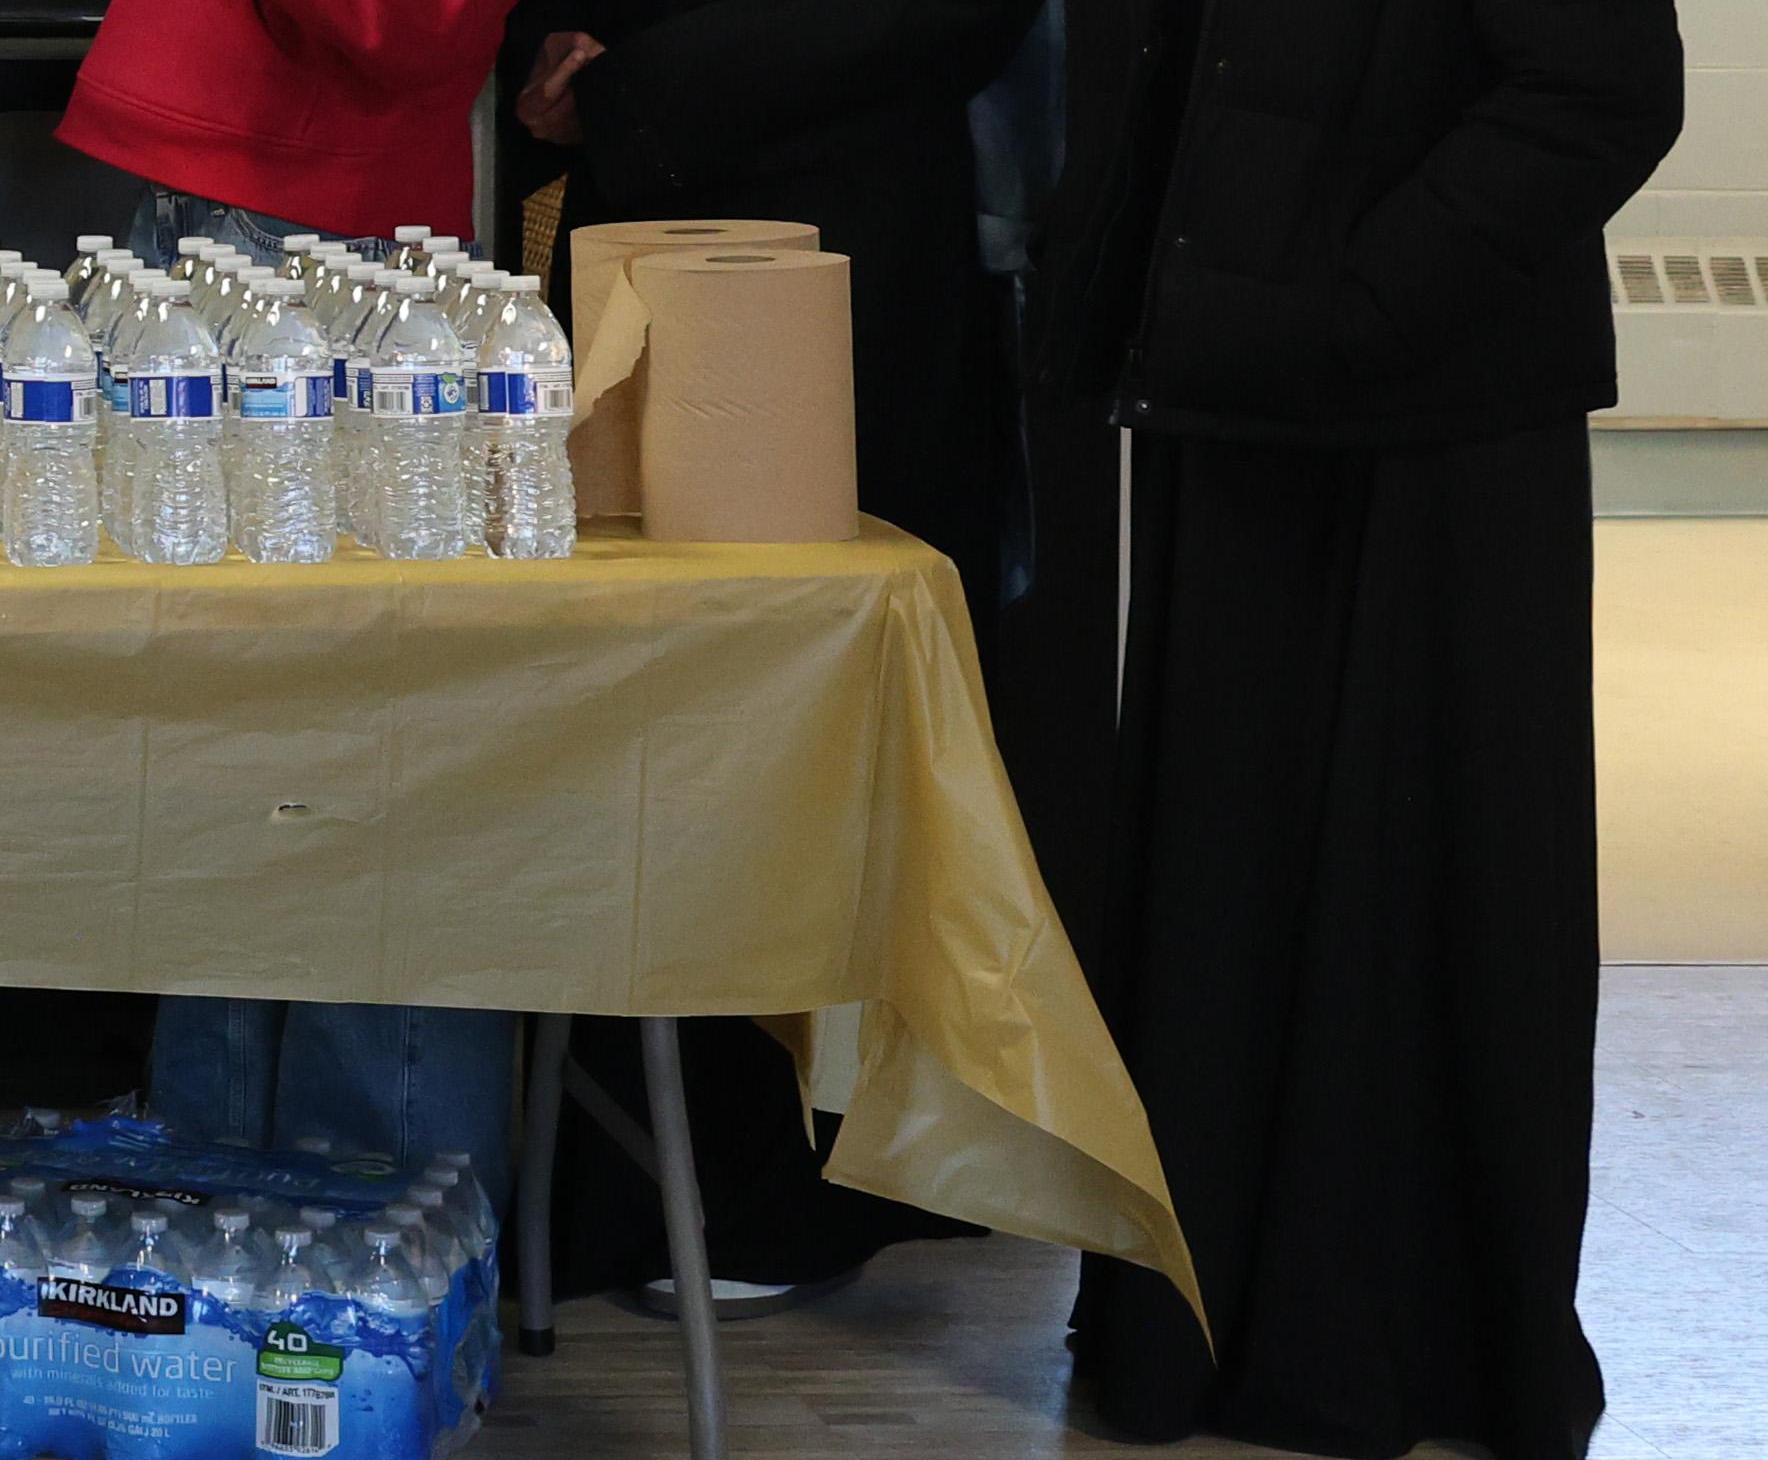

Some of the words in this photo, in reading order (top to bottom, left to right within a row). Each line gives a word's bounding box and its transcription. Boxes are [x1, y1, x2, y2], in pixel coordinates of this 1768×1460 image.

[43, 1281, 179, 1318] KIRKLAND
[267, 1329, 307, 1352] 40
[12, 1367, 43, 1381] with
[46, 1369, 104, 1388] minerals
[106, 1378, 148, 1396] added
[152, 1384, 170, 1397] for
[176, 1386, 214, 1399] taste
[132, 1351, 237, 1383] water
